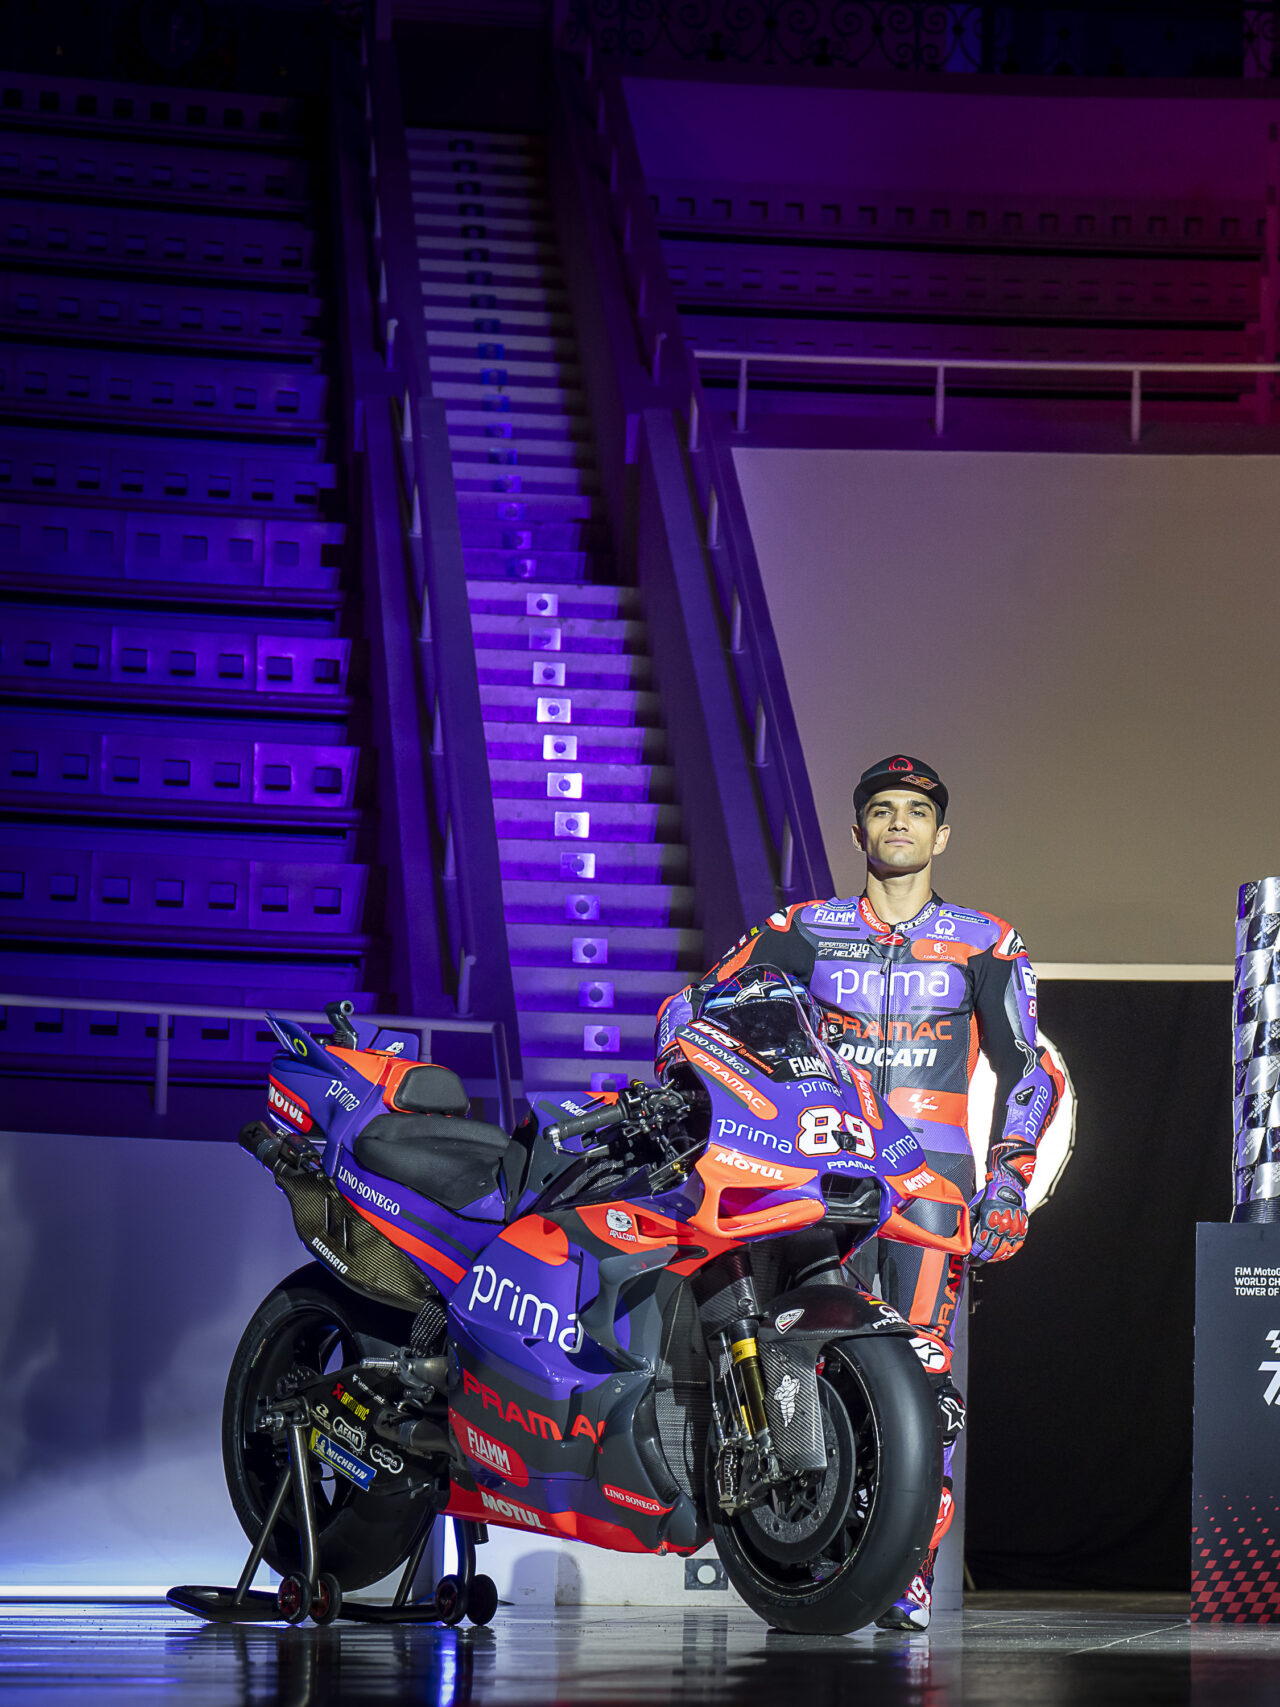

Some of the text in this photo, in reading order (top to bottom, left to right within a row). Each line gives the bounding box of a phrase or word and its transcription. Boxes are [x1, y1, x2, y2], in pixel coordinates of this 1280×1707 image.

[814, 909, 856, 923] FIAMM
[860, 900, 886, 932] PRAMAC
[833, 951, 869, 959] HELMET
[849, 942, 870, 952] R10
[830, 968, 950, 1004] prima
[690, 1022, 740, 1047] WRS
[826, 1012, 952, 1041] PRAMAC
[680, 1028, 750, 1075] LINO SONEGO
[837, 1043, 938, 1067] DUCATI
[325, 1080, 360, 1111] prima
[692, 1053, 767, 1110] PRAMAC
[798, 1081, 841, 1097] prima
[268, 1083, 303, 1124] MOTUL
[560, 1100, 587, 1117] DUCATI
[1025, 1086, 1048, 1139] prima
[717, 1119, 793, 1154] prima
[797, 1106, 877, 1160] 89
[714, 1152, 785, 1180] MOTUL
[882, 1134, 918, 1168] prima
[827, 1161, 877, 1173] PRAMAC
[903, 1171, 935, 1192] MOTUL
[338, 1166, 399, 1215] LINO SONEGO
[312, 1237, 348, 1274] ACCOSSATO
[1235, 1267, 1251, 1275] FIM
[1235, 1277, 1266, 1286] WORLD
[1234, 1287, 1266, 1295] TOWER
[1268, 1288, 1279, 1296] OF
[468, 1265, 584, 1353] prima
[338, 1424, 358, 1446] AFAM
[467, 1427, 511, 1471] FIAMM
[326, 1446, 368, 1480] MICHELIN
[481, 1491, 546, 1528] MOTUL
[604, 1488, 660, 1511] LINO SONEGO
